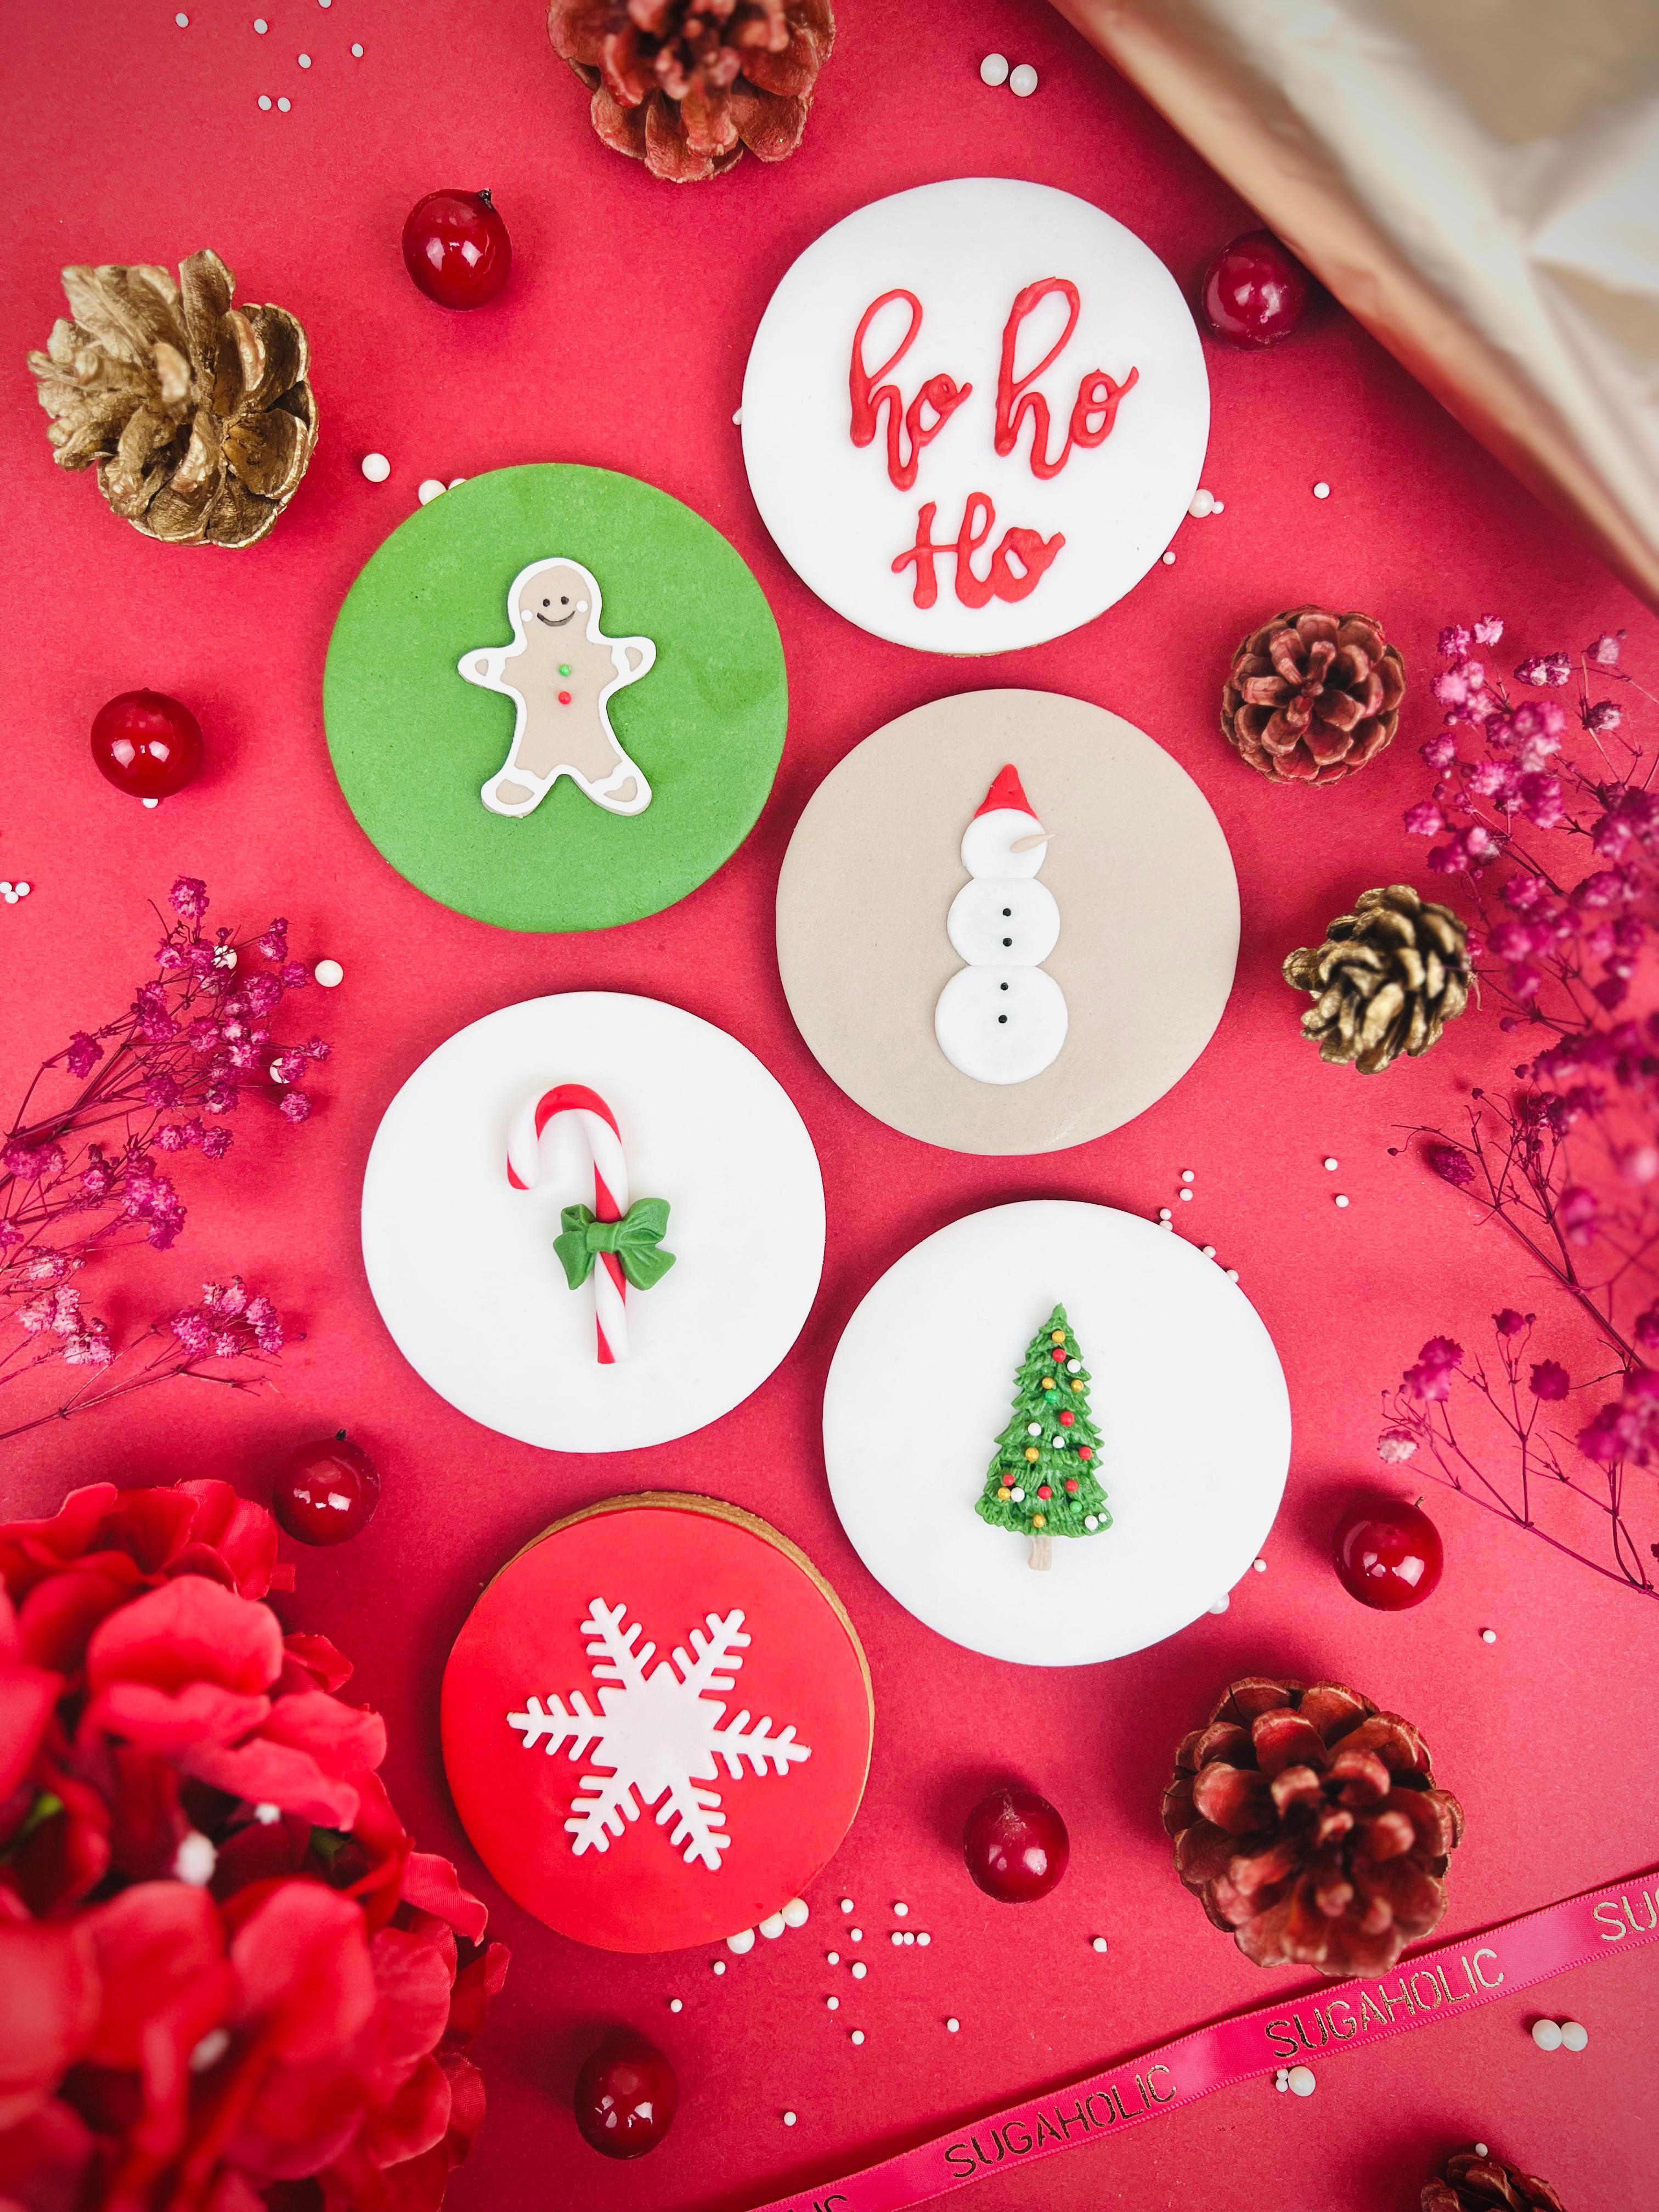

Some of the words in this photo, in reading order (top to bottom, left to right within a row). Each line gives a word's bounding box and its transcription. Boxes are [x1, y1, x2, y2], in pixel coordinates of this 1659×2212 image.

[849, 288, 973, 492] ho
[994, 276, 1139, 481] ho
[945, 2064, 1177, 2178] SUGAHOLIC
[1265, 1948, 1504, 2058] SUGAHOLIC
[1593, 1887, 1659, 1941] SU
